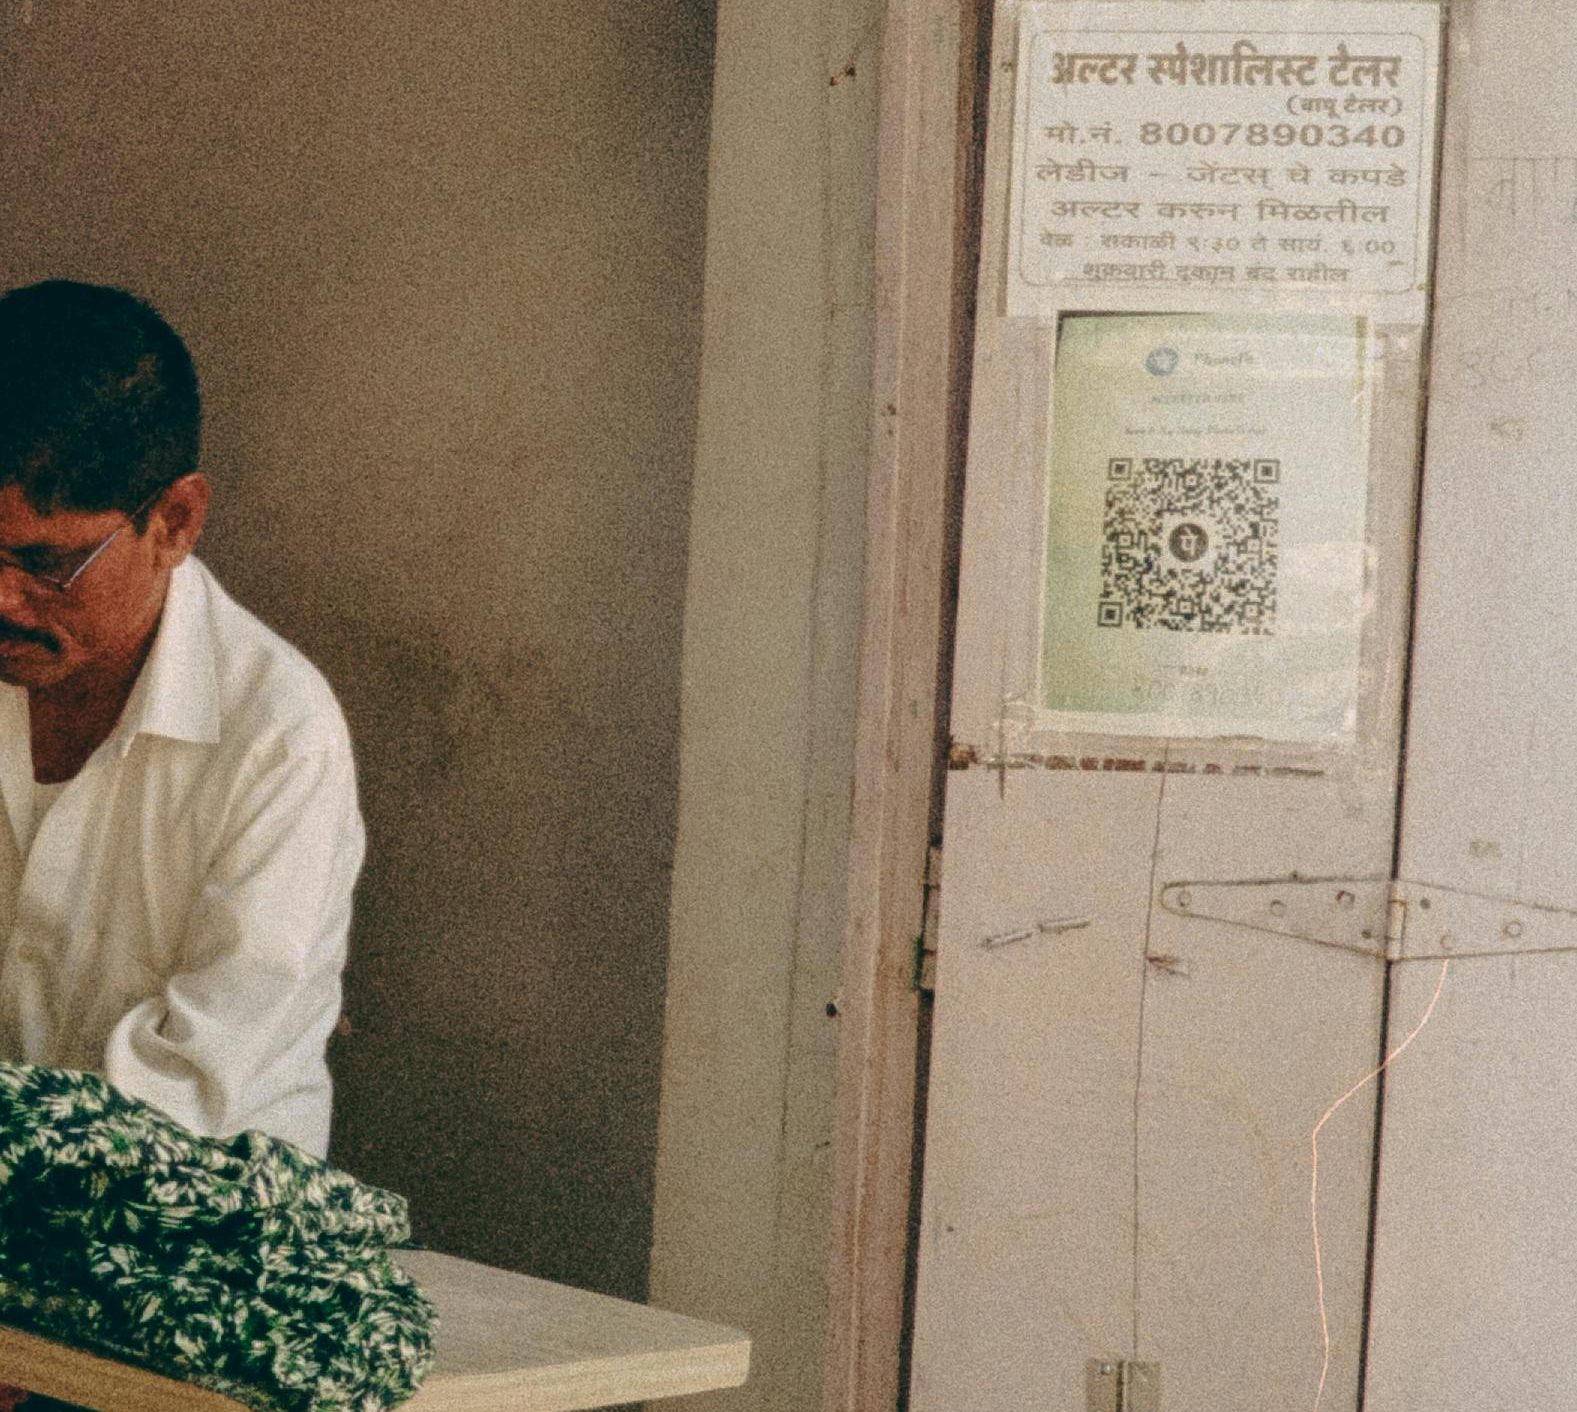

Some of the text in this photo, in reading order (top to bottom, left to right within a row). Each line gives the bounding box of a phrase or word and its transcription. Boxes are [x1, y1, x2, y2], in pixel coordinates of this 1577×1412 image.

[1051, 41, 1403, 89] अल्टर स्पेशालिस्ट टेलर
[1343, 94, 1403, 117] टेलर)
[1139, 121, 1406, 149] 8007890340
[1035, 157, 1129, 184] लेडीज
[1285, 160, 1313, 187] चे
[1328, 162, 1408, 189] कपडे
[1050, 199, 1141, 220] अल्टर
[1256, 196, 1391, 224] मिळतील
